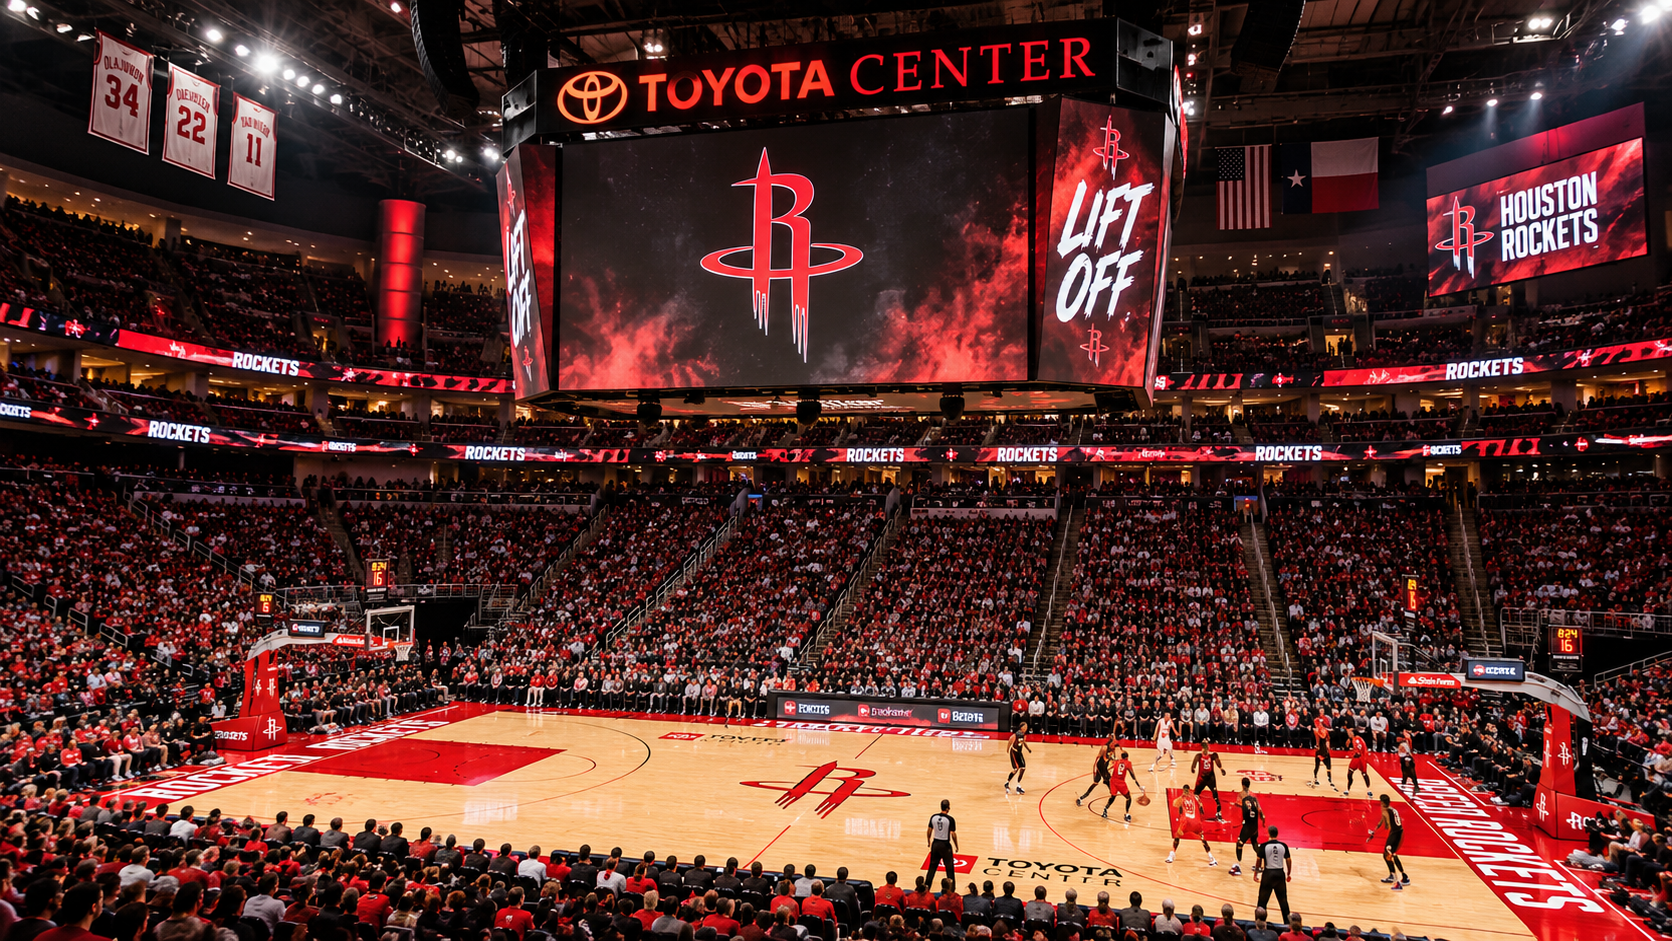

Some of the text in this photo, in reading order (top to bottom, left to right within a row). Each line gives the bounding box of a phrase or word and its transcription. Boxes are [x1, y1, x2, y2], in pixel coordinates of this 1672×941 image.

[638, 37, 1096, 112] TOYOTA CENTER
[105, 74, 140, 118] 34
[176, 105, 207, 145] 22
[246, 133, 262, 167] 11
[1500, 171, 1598, 228] HOUSTON
[1056, 179, 1155, 259] LIFT
[1501, 208, 1599, 262] ROCKETS
[1055, 250, 1144, 323] OFF
[232, 352, 300, 377] ROCKETS
[1445, 357, 1524, 381] ROCKETS
[147, 421, 211, 444] ROCKETS
[465, 446, 526, 462] ROCKETS
[846, 447, 905, 463] ROCKETS
[996, 446, 1058, 463] ROCKETS
[1255, 444, 1323, 462] ROCKETS
[373, 571, 383, 586] 16
[1561, 639, 1573, 652] 16
[987, 857, 1123, 878] TOYOTA
[1430, 816, 1605, 913] ROCKETS
